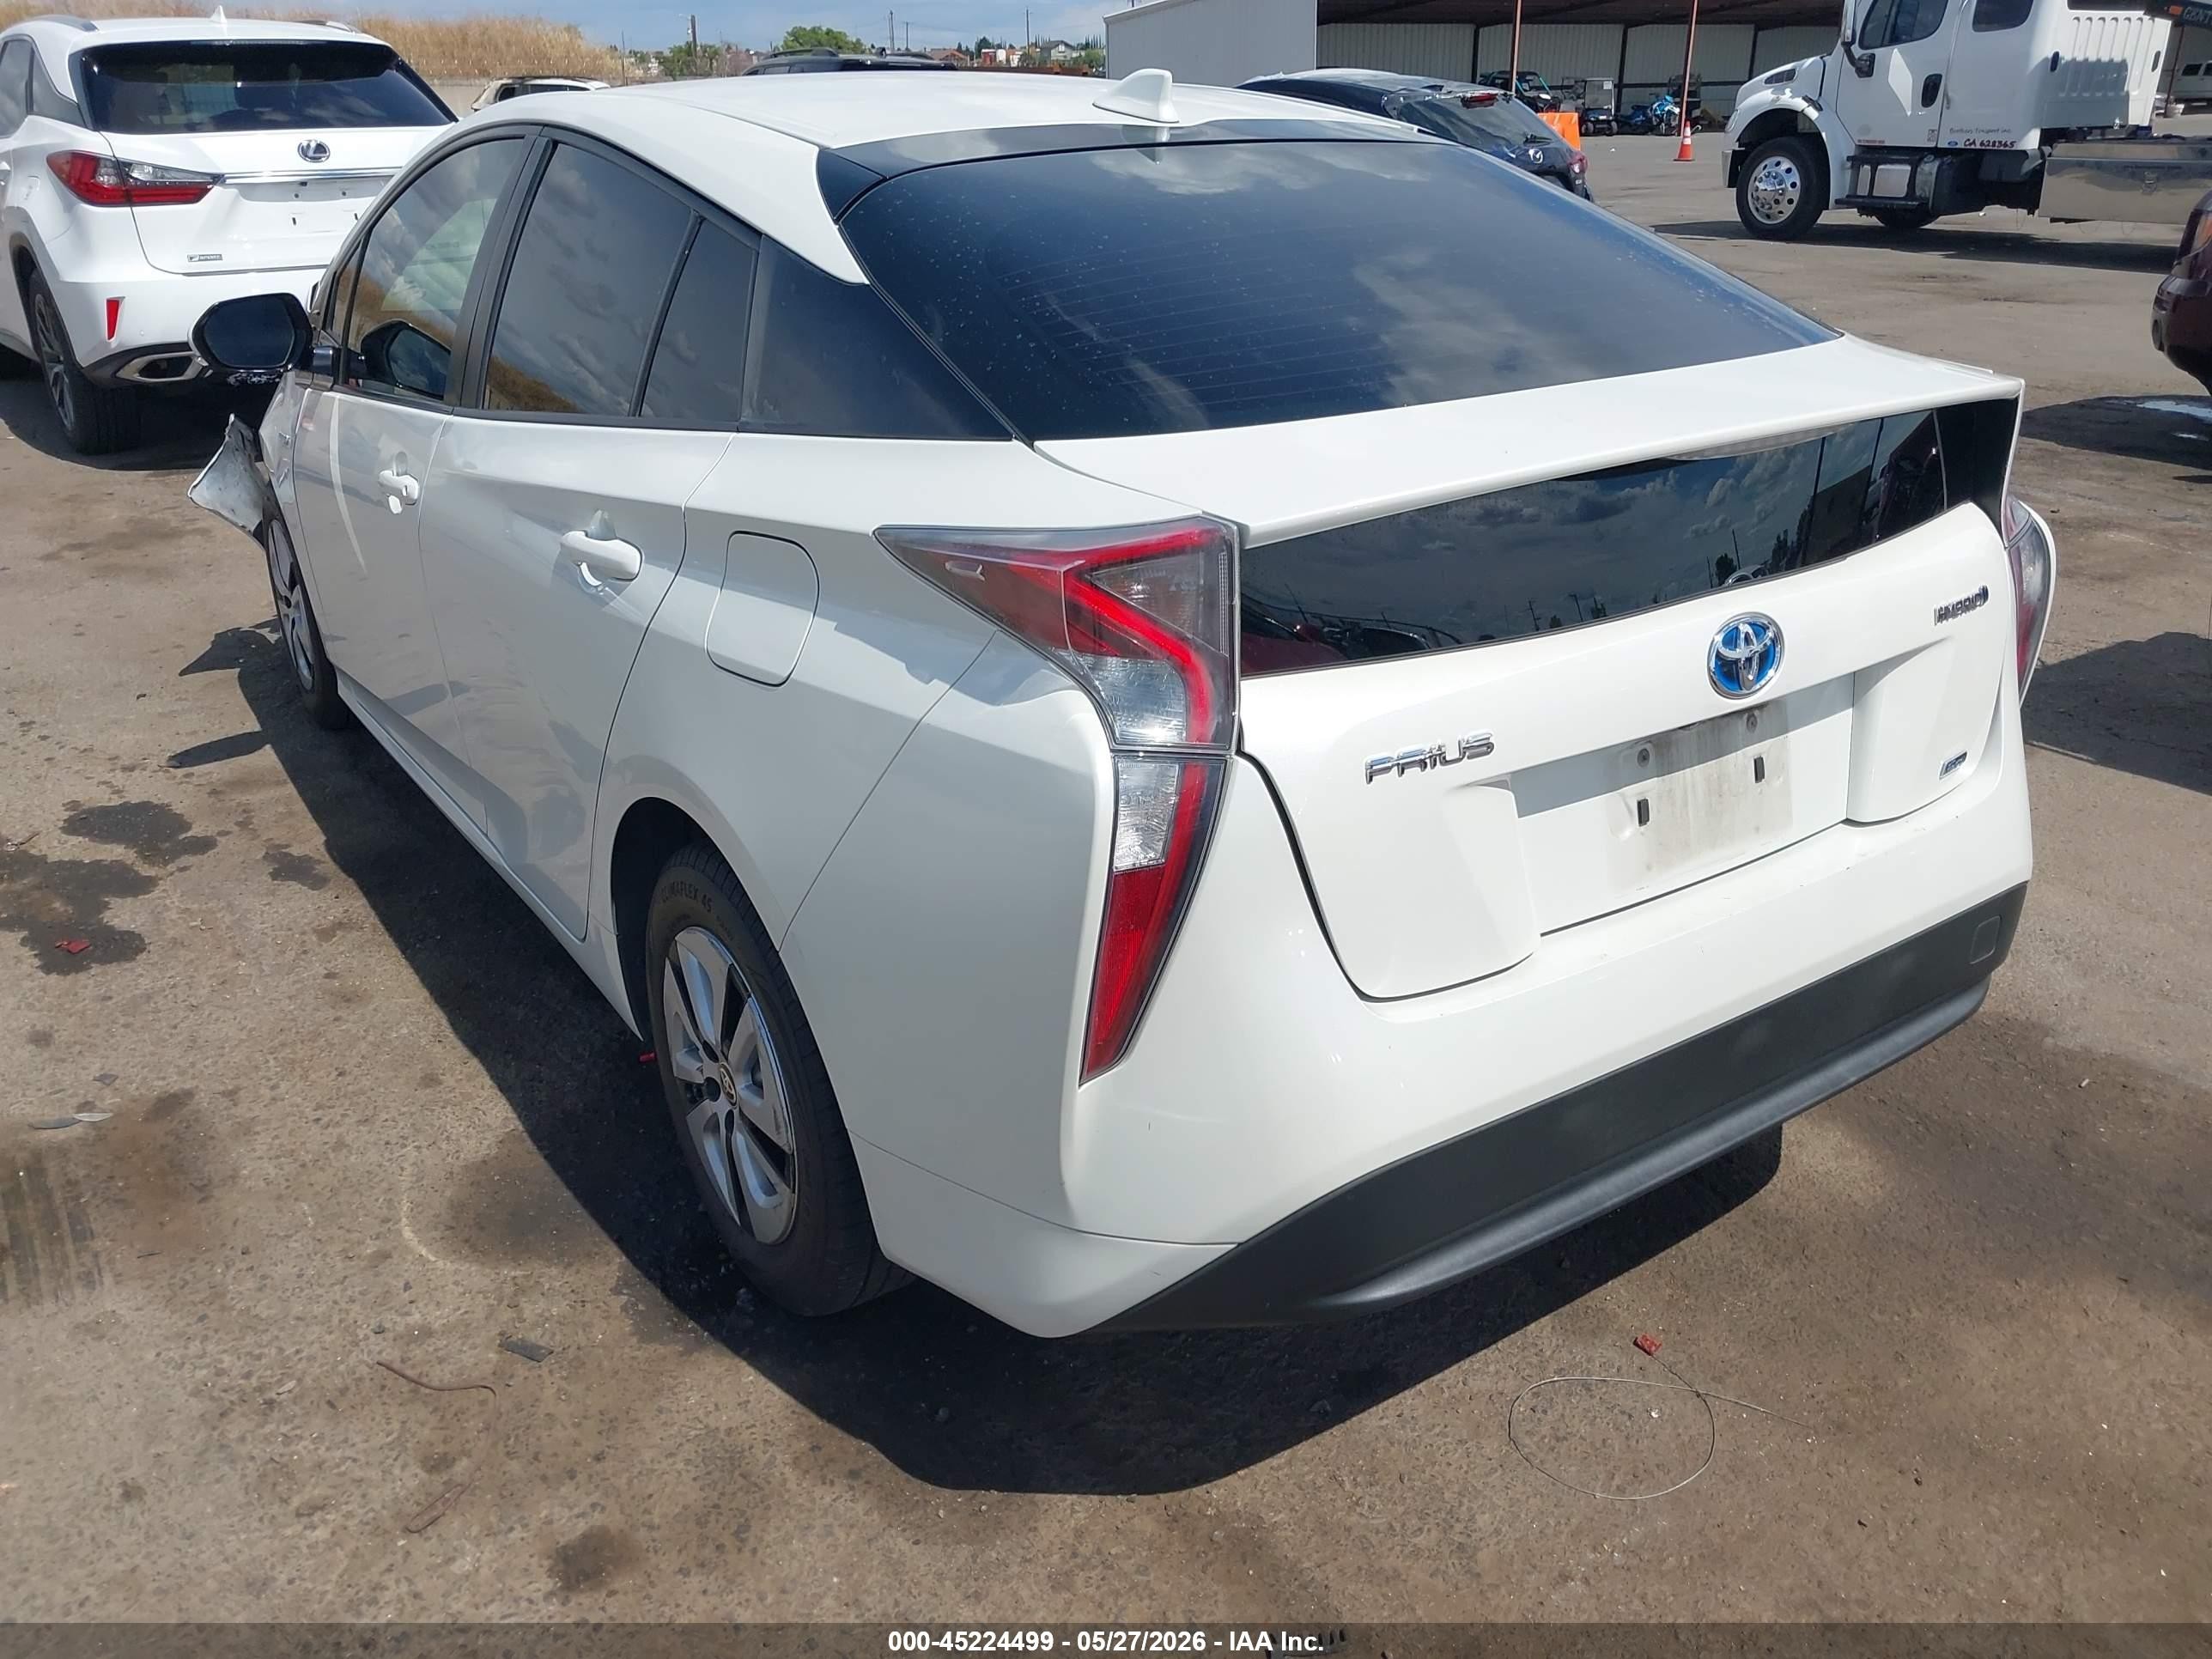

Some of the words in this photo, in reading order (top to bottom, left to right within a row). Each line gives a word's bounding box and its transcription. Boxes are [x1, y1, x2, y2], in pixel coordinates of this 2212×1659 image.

[1964, 138, 1977, 147] CA
[1979, 139, 2016, 149] 628365
[1364, 732, 1495, 785] PRIUS
